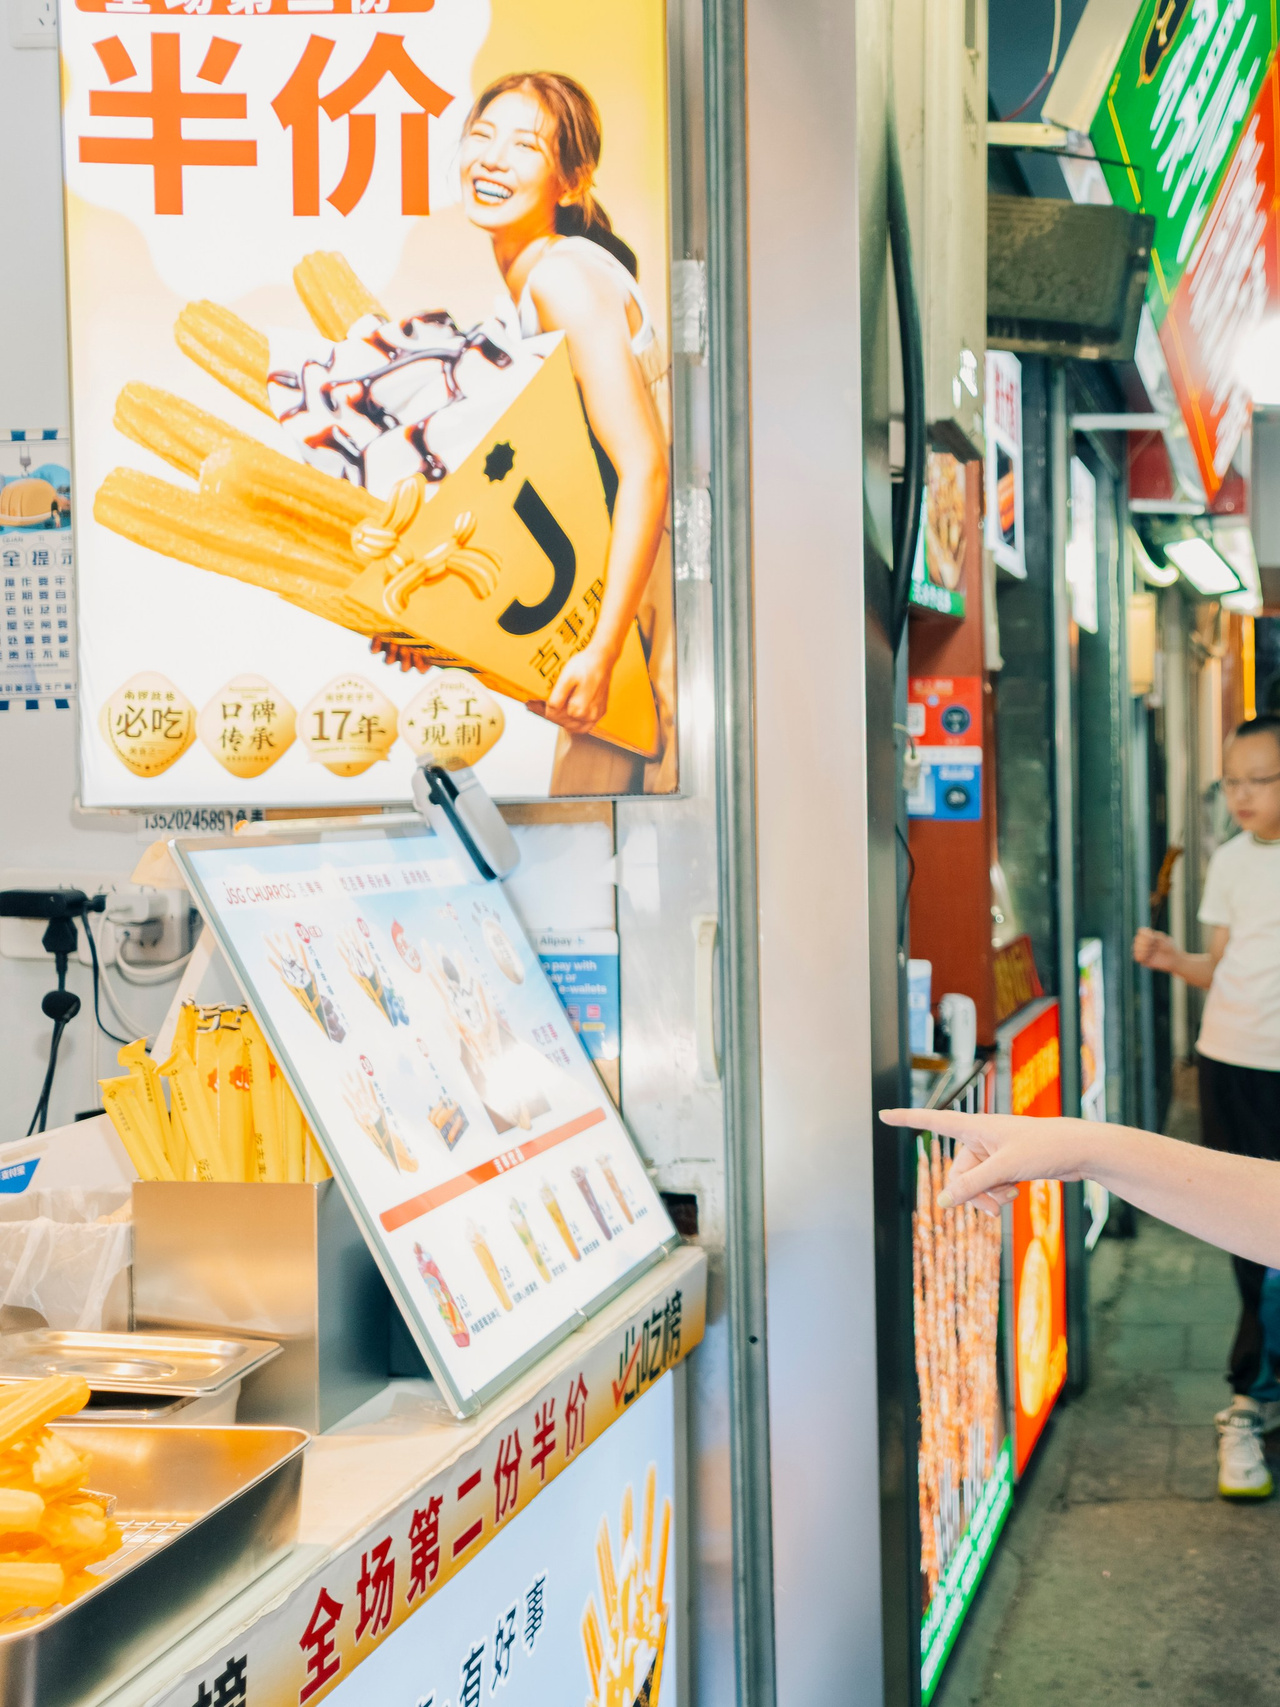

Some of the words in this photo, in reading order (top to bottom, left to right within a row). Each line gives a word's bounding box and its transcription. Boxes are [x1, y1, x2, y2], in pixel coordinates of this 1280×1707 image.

[78, 31, 456, 217] 半价
[221, 699, 278, 724] 口碑
[421, 696, 483, 720] 手工
[116, 704, 184, 740] 必吃
[311, 708, 387, 743] 17年
[218, 725, 277, 752] 传承
[421, 723, 482, 747] 现制
[245, 882, 297, 904] CHURROS
[539, 935, 572, 948] Alipay
[552, 961, 571, 973] pay
[573, 959, 597, 971] with
[558, 983, 608, 995] e-wallets
[299, 1372, 589, 1705] 全场第二份半价
